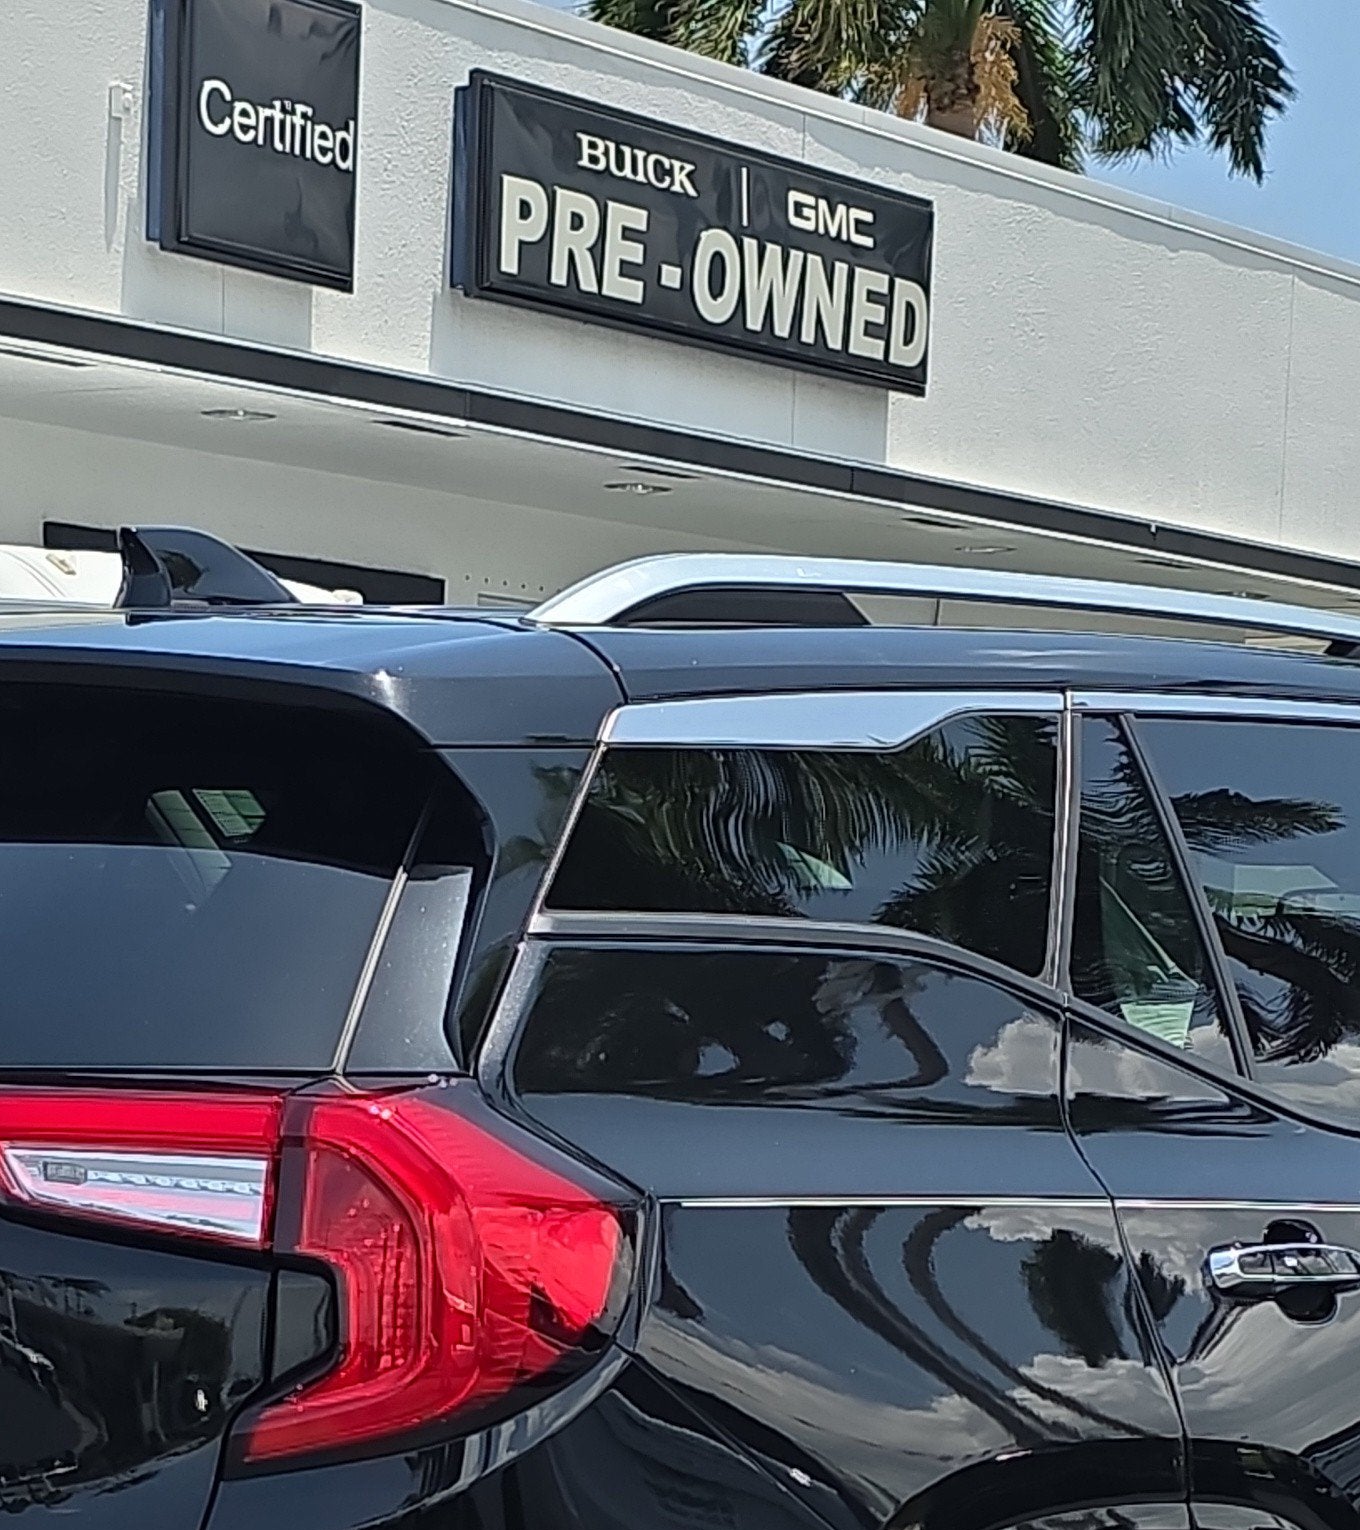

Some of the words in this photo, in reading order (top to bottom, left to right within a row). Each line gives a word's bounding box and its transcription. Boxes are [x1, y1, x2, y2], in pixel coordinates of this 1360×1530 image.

[197, 79, 354, 172] Certified
[576, 131, 699, 198] BUICK
[786, 190, 875, 248] GMC
